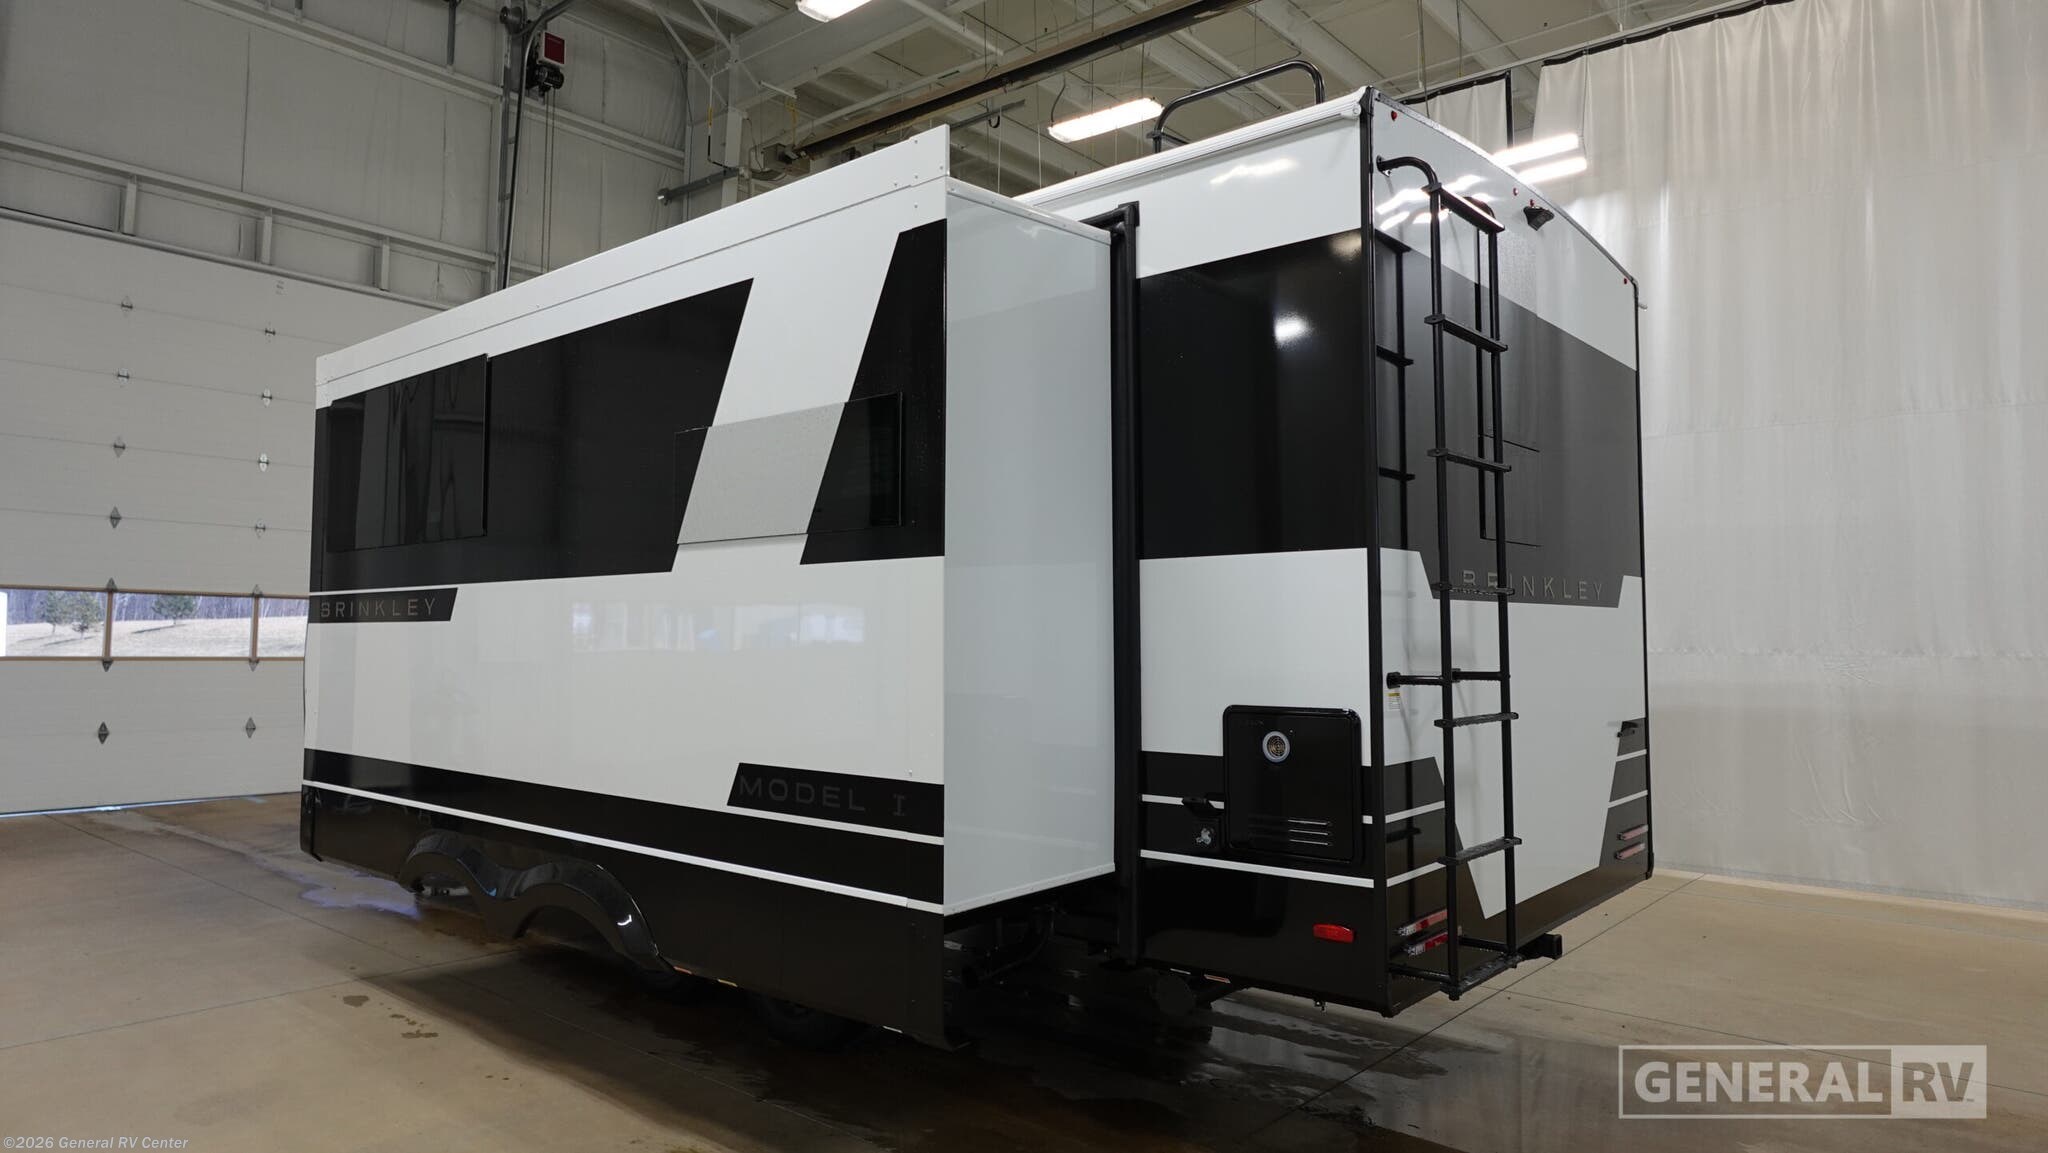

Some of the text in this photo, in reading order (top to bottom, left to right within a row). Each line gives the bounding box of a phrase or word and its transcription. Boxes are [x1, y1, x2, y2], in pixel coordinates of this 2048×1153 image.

[320, 598, 436, 618] BRINKLEY
[738, 775, 907, 816] MODEL I
